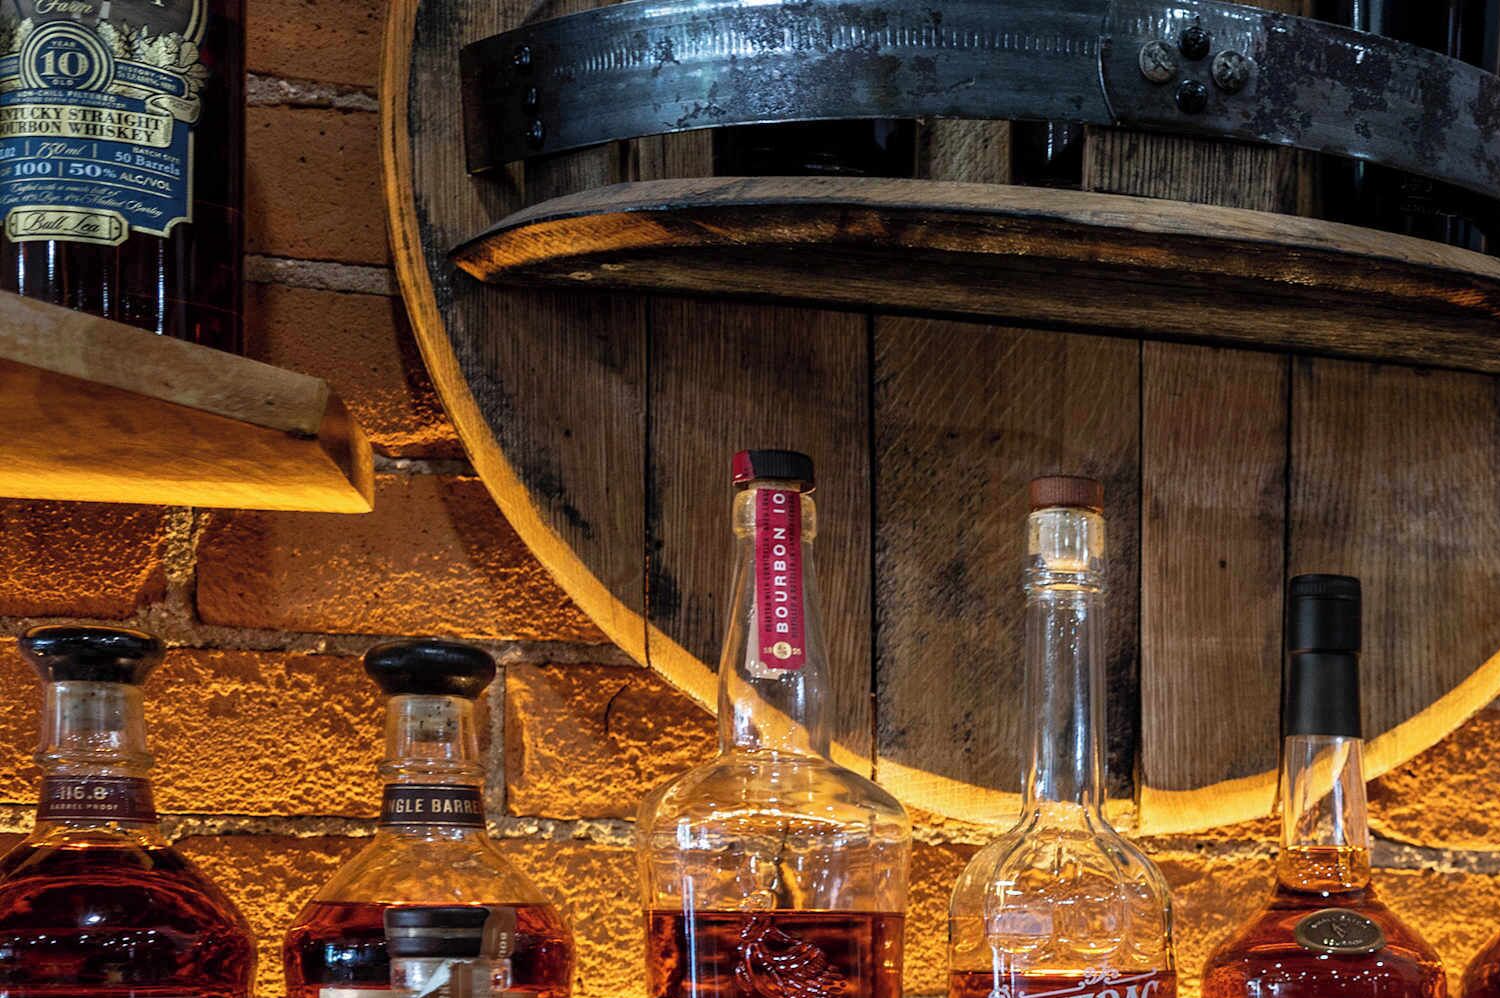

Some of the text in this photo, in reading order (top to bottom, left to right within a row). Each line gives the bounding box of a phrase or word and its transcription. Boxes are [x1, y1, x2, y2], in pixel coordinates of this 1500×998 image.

[51, 40, 77, 48] YEAR
[40, 51, 90, 78] 10
[68, 106, 164, 131] STRAIGHT
[68, 122, 155, 142] WHISKEY
[14, 162, 52, 177] 100
[114, 151, 181, 176] 50 Barrels
[68, 162, 173, 192] 50% ALC/VOL
[64, 213, 101, 233] Lea
[772, 527, 789, 633] BOURBON
